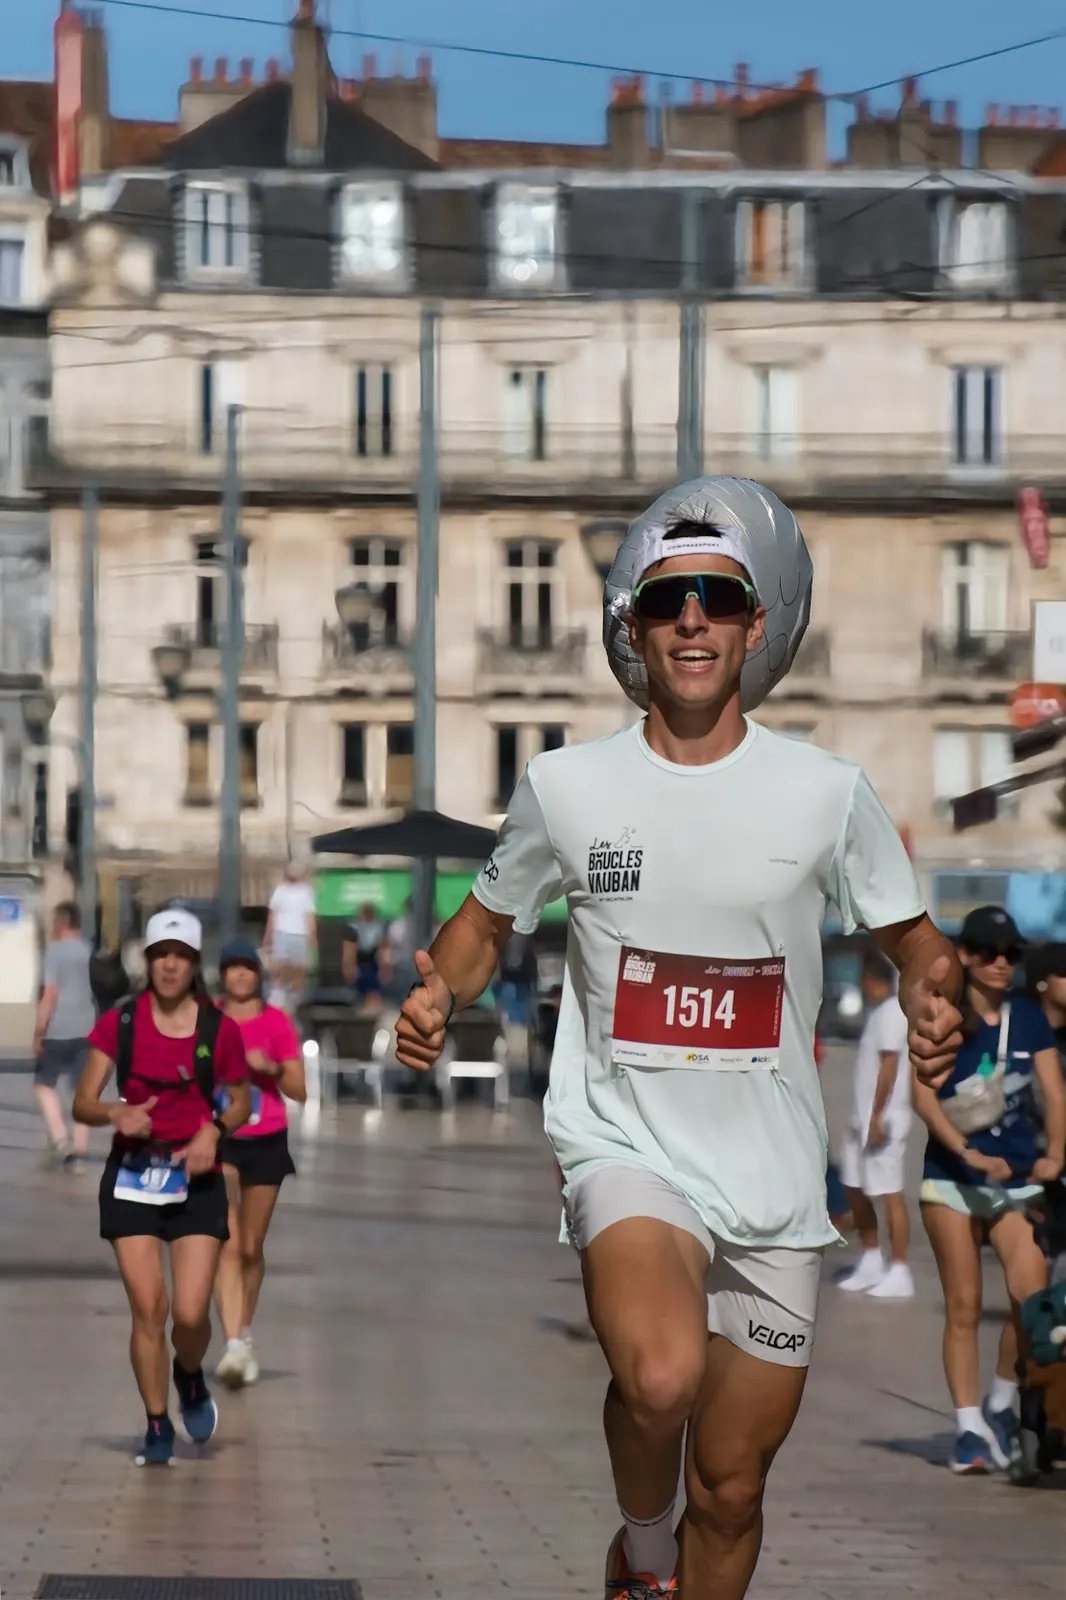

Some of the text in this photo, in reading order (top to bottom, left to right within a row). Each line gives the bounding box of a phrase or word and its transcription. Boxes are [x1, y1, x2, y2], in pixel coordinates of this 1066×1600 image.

[589, 837, 612, 851] Les
[588, 849, 643, 871] BOUCLES
[588, 870, 641, 894] VAUBAN
[663, 985, 736, 1030] 1514
[748, 1319, 806, 1353] VELCAP
